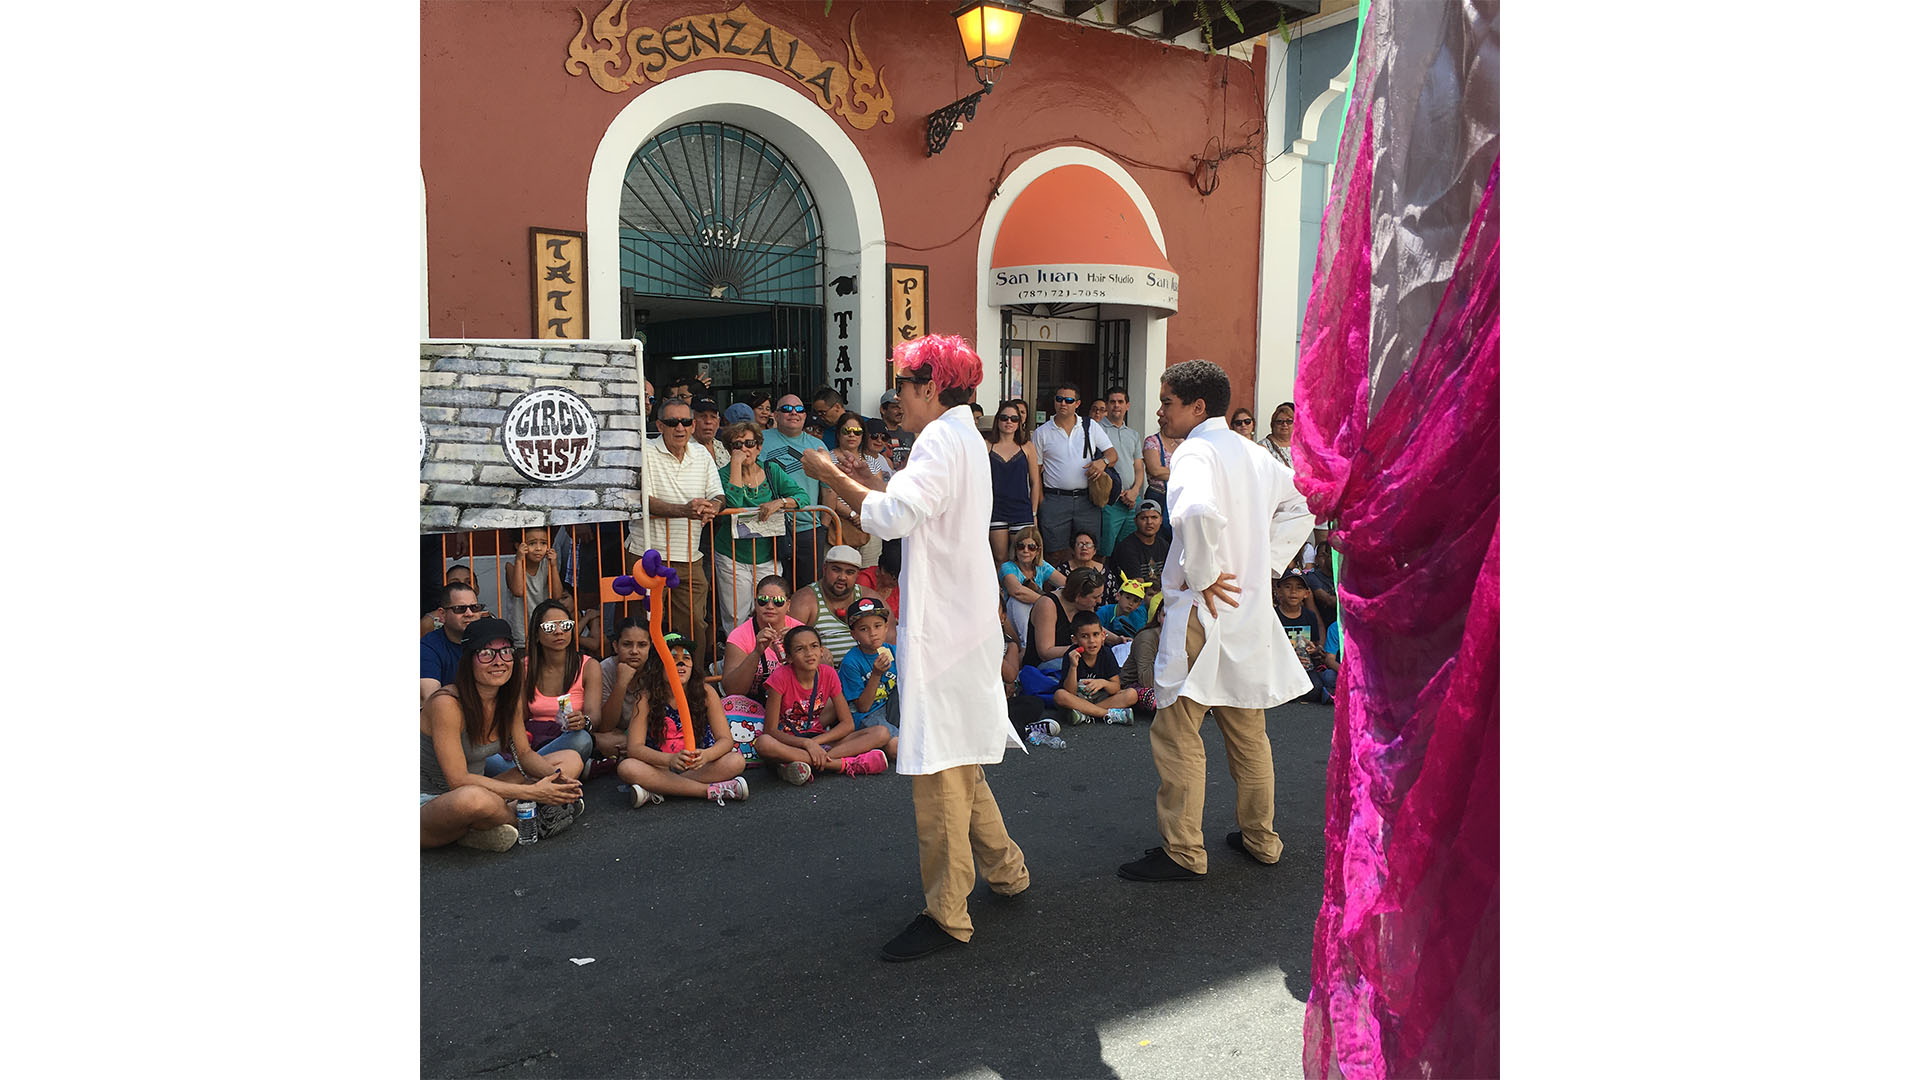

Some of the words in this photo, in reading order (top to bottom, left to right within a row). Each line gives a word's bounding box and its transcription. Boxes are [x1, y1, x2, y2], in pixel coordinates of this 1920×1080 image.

[636, 17, 835, 104] SENZALA
[995, 272, 1029, 286] San
[1038, 269, 1079, 284] Juan
[1087, 273, 1106, 283] Hair
[1108, 274, 1134, 284] Studio
[1018, 289, 1048, 299] (787)
[1051, 289, 1106, 297] 721-7058
[1146, 272, 1168, 289] San
[833, 310, 853, 405] TAT
[515, 399, 588, 437] CIRCO
[515, 437, 589, 475] FEST
